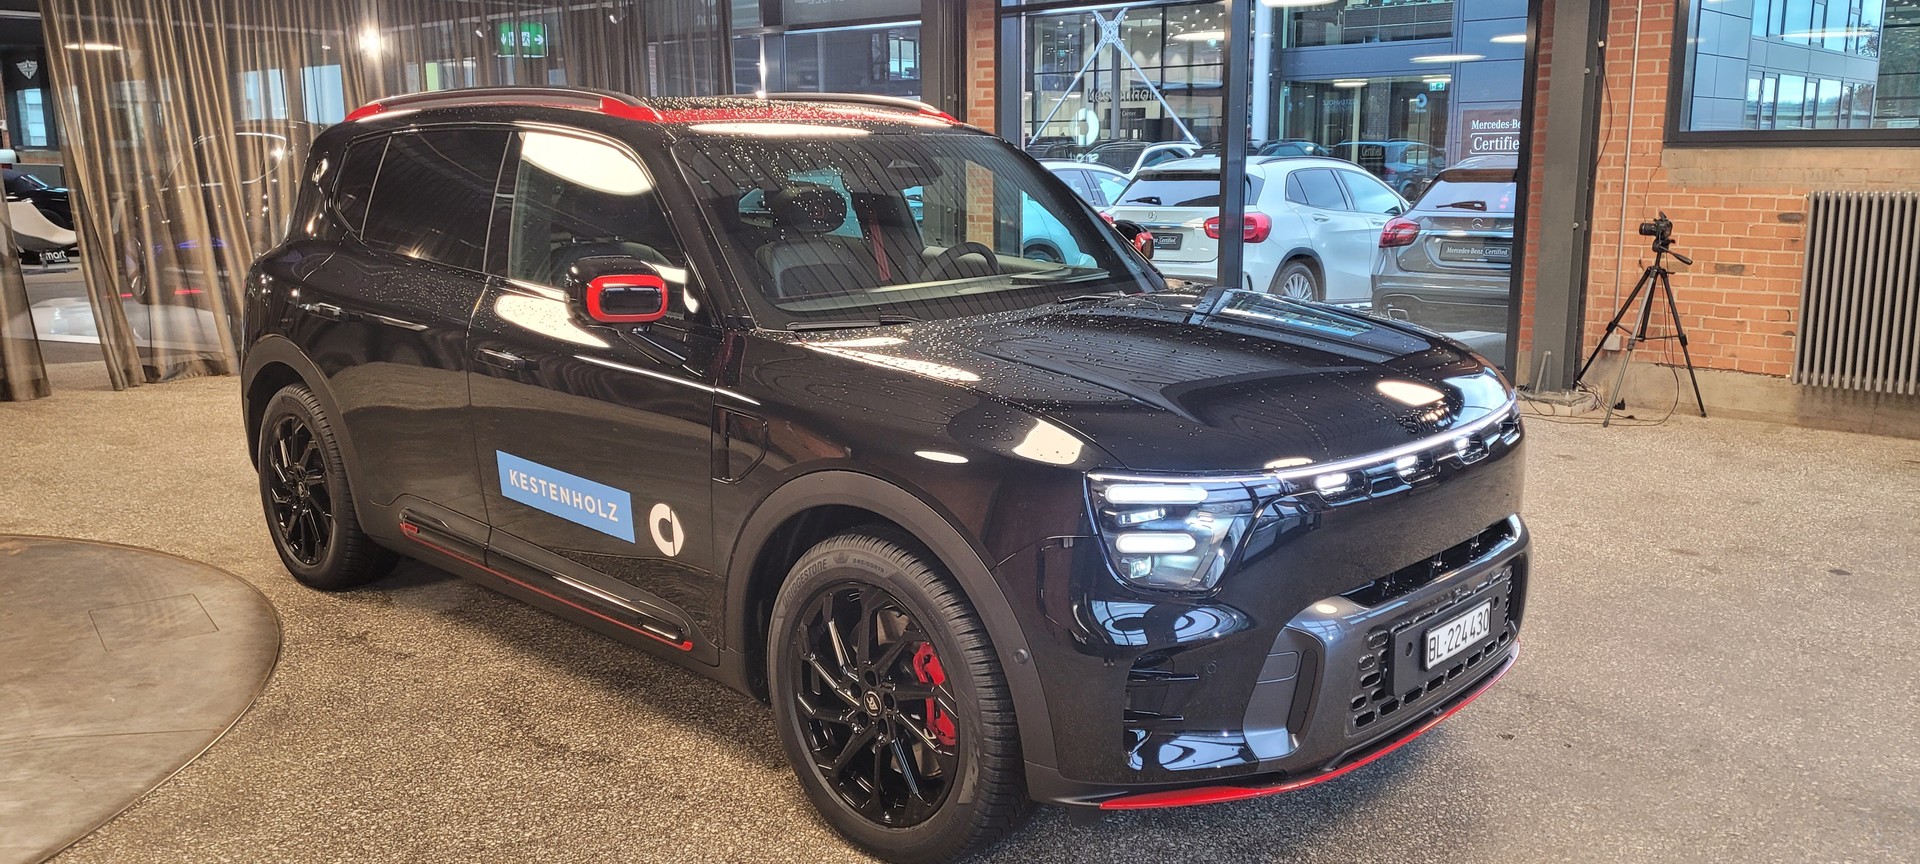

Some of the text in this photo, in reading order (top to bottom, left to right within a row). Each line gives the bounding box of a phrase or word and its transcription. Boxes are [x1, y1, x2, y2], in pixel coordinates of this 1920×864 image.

[1446, 246, 1483, 255] Mercedes-Benz
[508, 468, 619, 522] KESTENHOLZ
[782, 558, 828, 608] BRIDGESTONE
